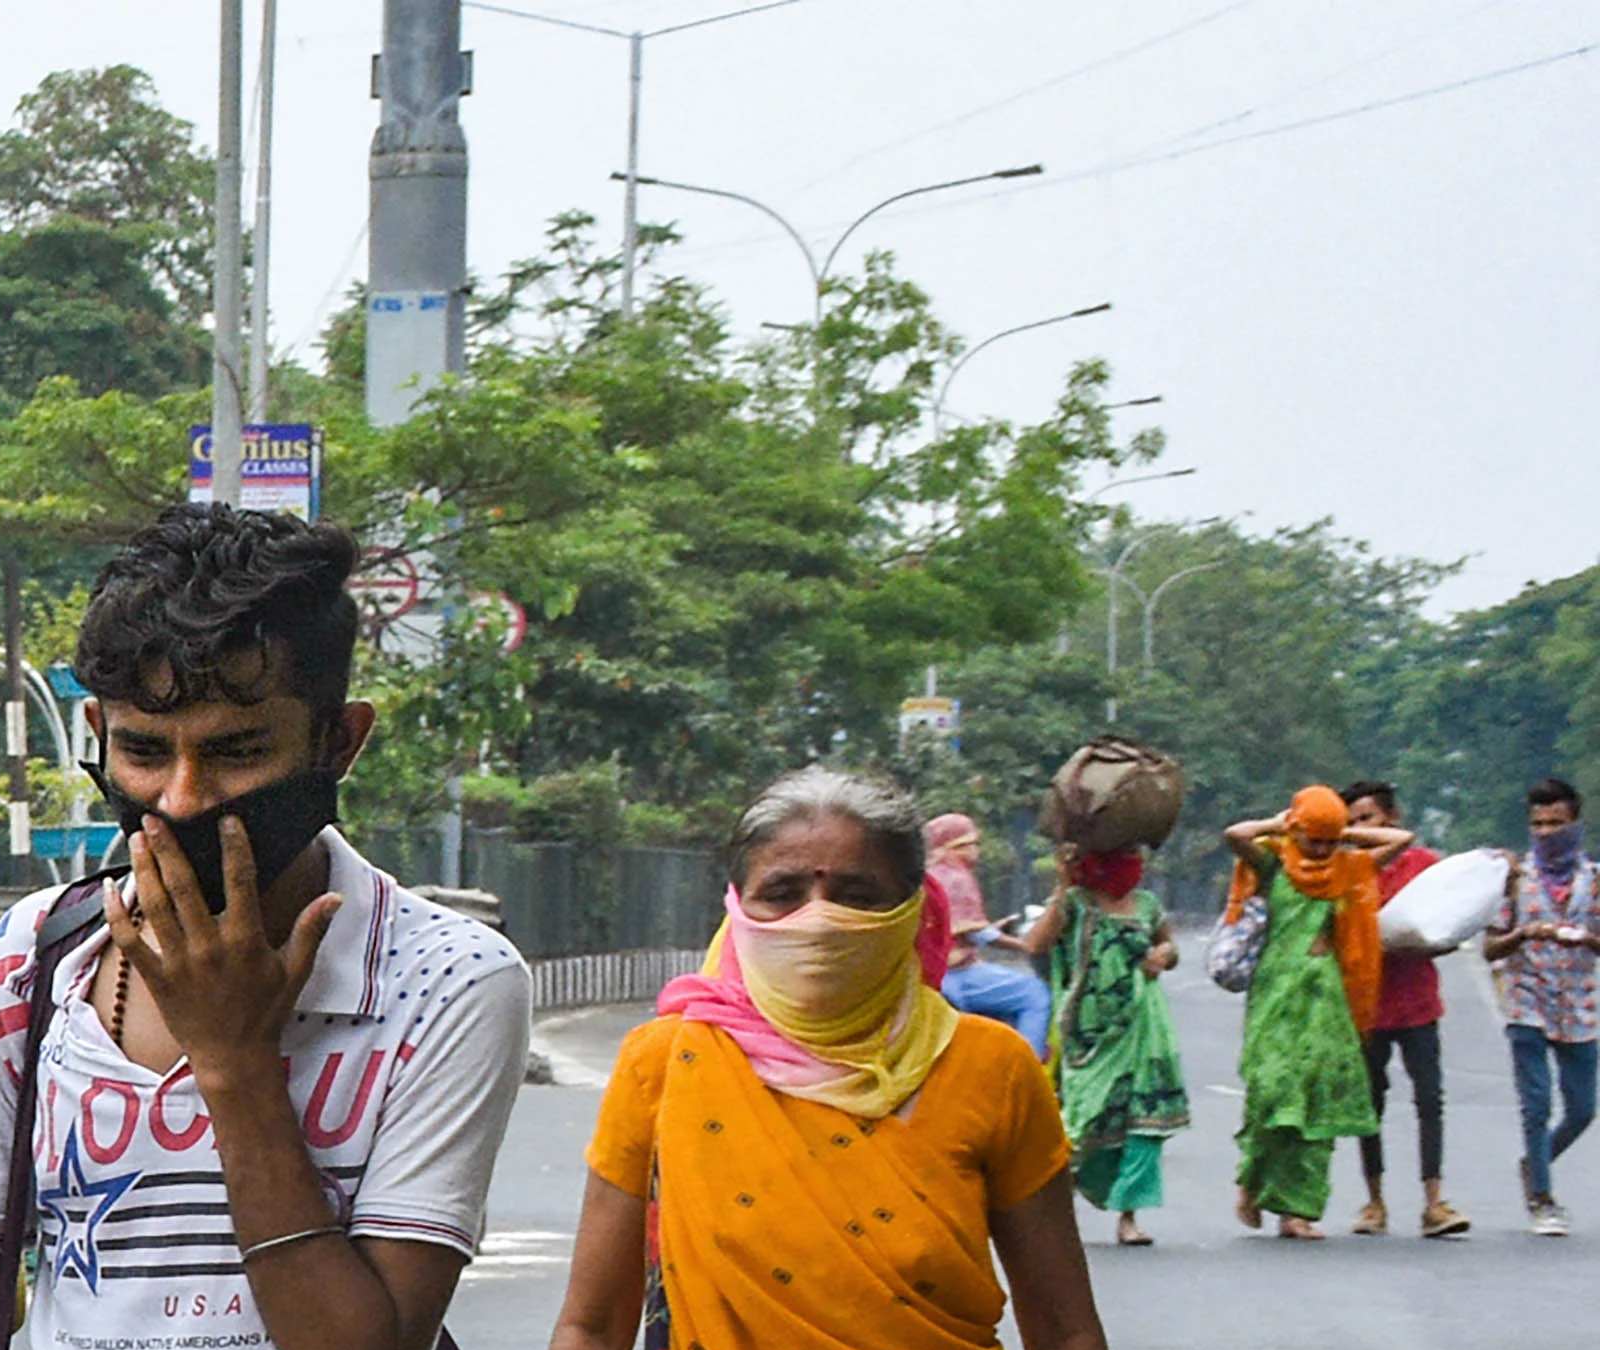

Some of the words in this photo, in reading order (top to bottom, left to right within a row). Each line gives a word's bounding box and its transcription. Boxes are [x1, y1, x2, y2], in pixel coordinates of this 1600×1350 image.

[192, 432, 308, 461] Gnius
[242, 460, 309, 475] CLASSES
[174, 1331, 262, 1350] AMERICANS
